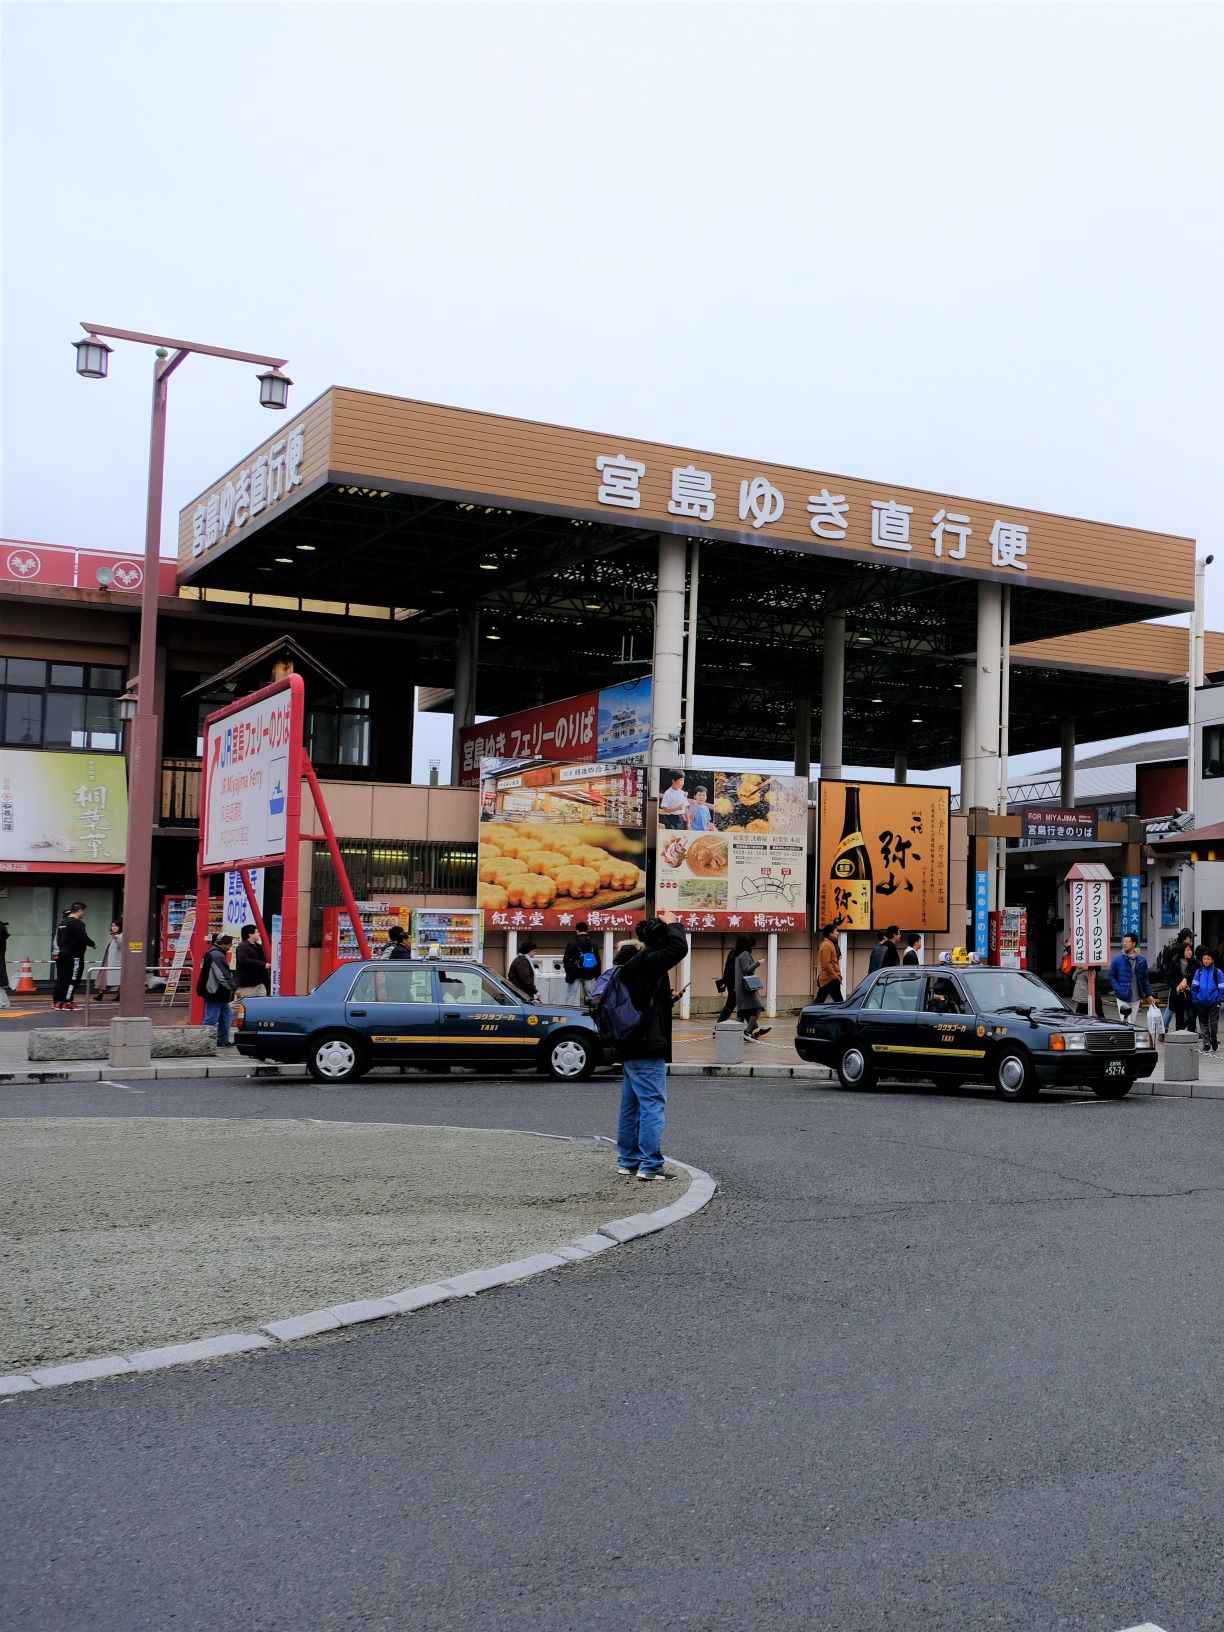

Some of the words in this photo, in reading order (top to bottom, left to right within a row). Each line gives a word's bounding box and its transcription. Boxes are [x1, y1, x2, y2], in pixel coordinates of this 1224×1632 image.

[192, 424, 305, 558] 宮島ゆき直行便
[596, 454, 1029, 571] 宮島ゆき直行便
[511, 706, 595, 758] フェリーのりば
[1028, 812, 1041, 820] FOR
[1045, 813, 1076, 822] MIYAJIMA
[1028, 824, 1092, 838] 宮島行きのりば
[875, 830, 921, 895] 弥山
[491, 911, 544, 925] 紅葉堂
[1075, 883, 1084, 961] タクシーのりば
[1093, 883, 1103, 961] タクシーのりば
[1131, 878, 1139, 933] 宮島松大汽
[941, 1034, 954, 1042] TAXI
